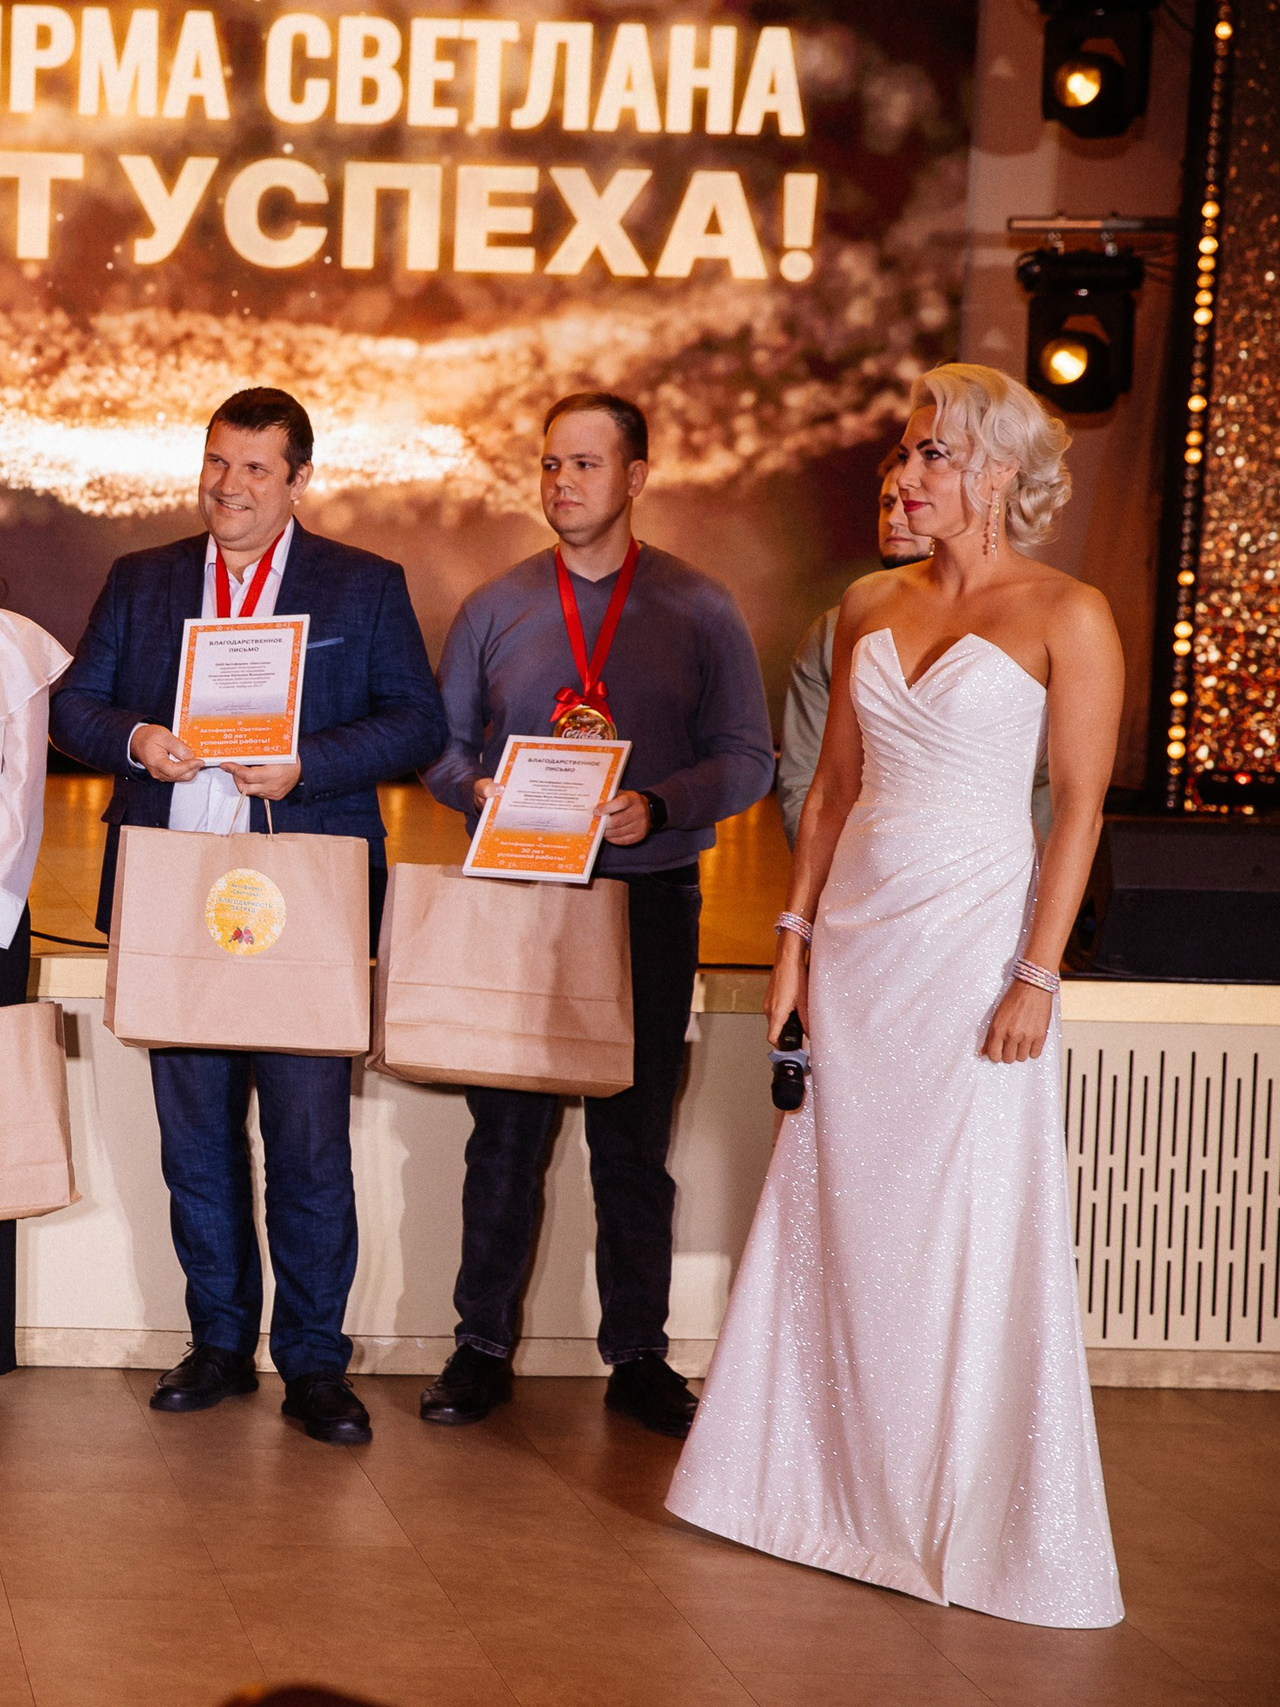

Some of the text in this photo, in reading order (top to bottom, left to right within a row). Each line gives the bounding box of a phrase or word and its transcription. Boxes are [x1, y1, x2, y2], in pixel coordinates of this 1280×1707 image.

[264, 13, 805, 137] СВЕТЛАНА
[119, 154, 820, 284] УСПЕХА!
[528, 758, 600, 766] БЛАГОДАРСТВЕННОЕ
